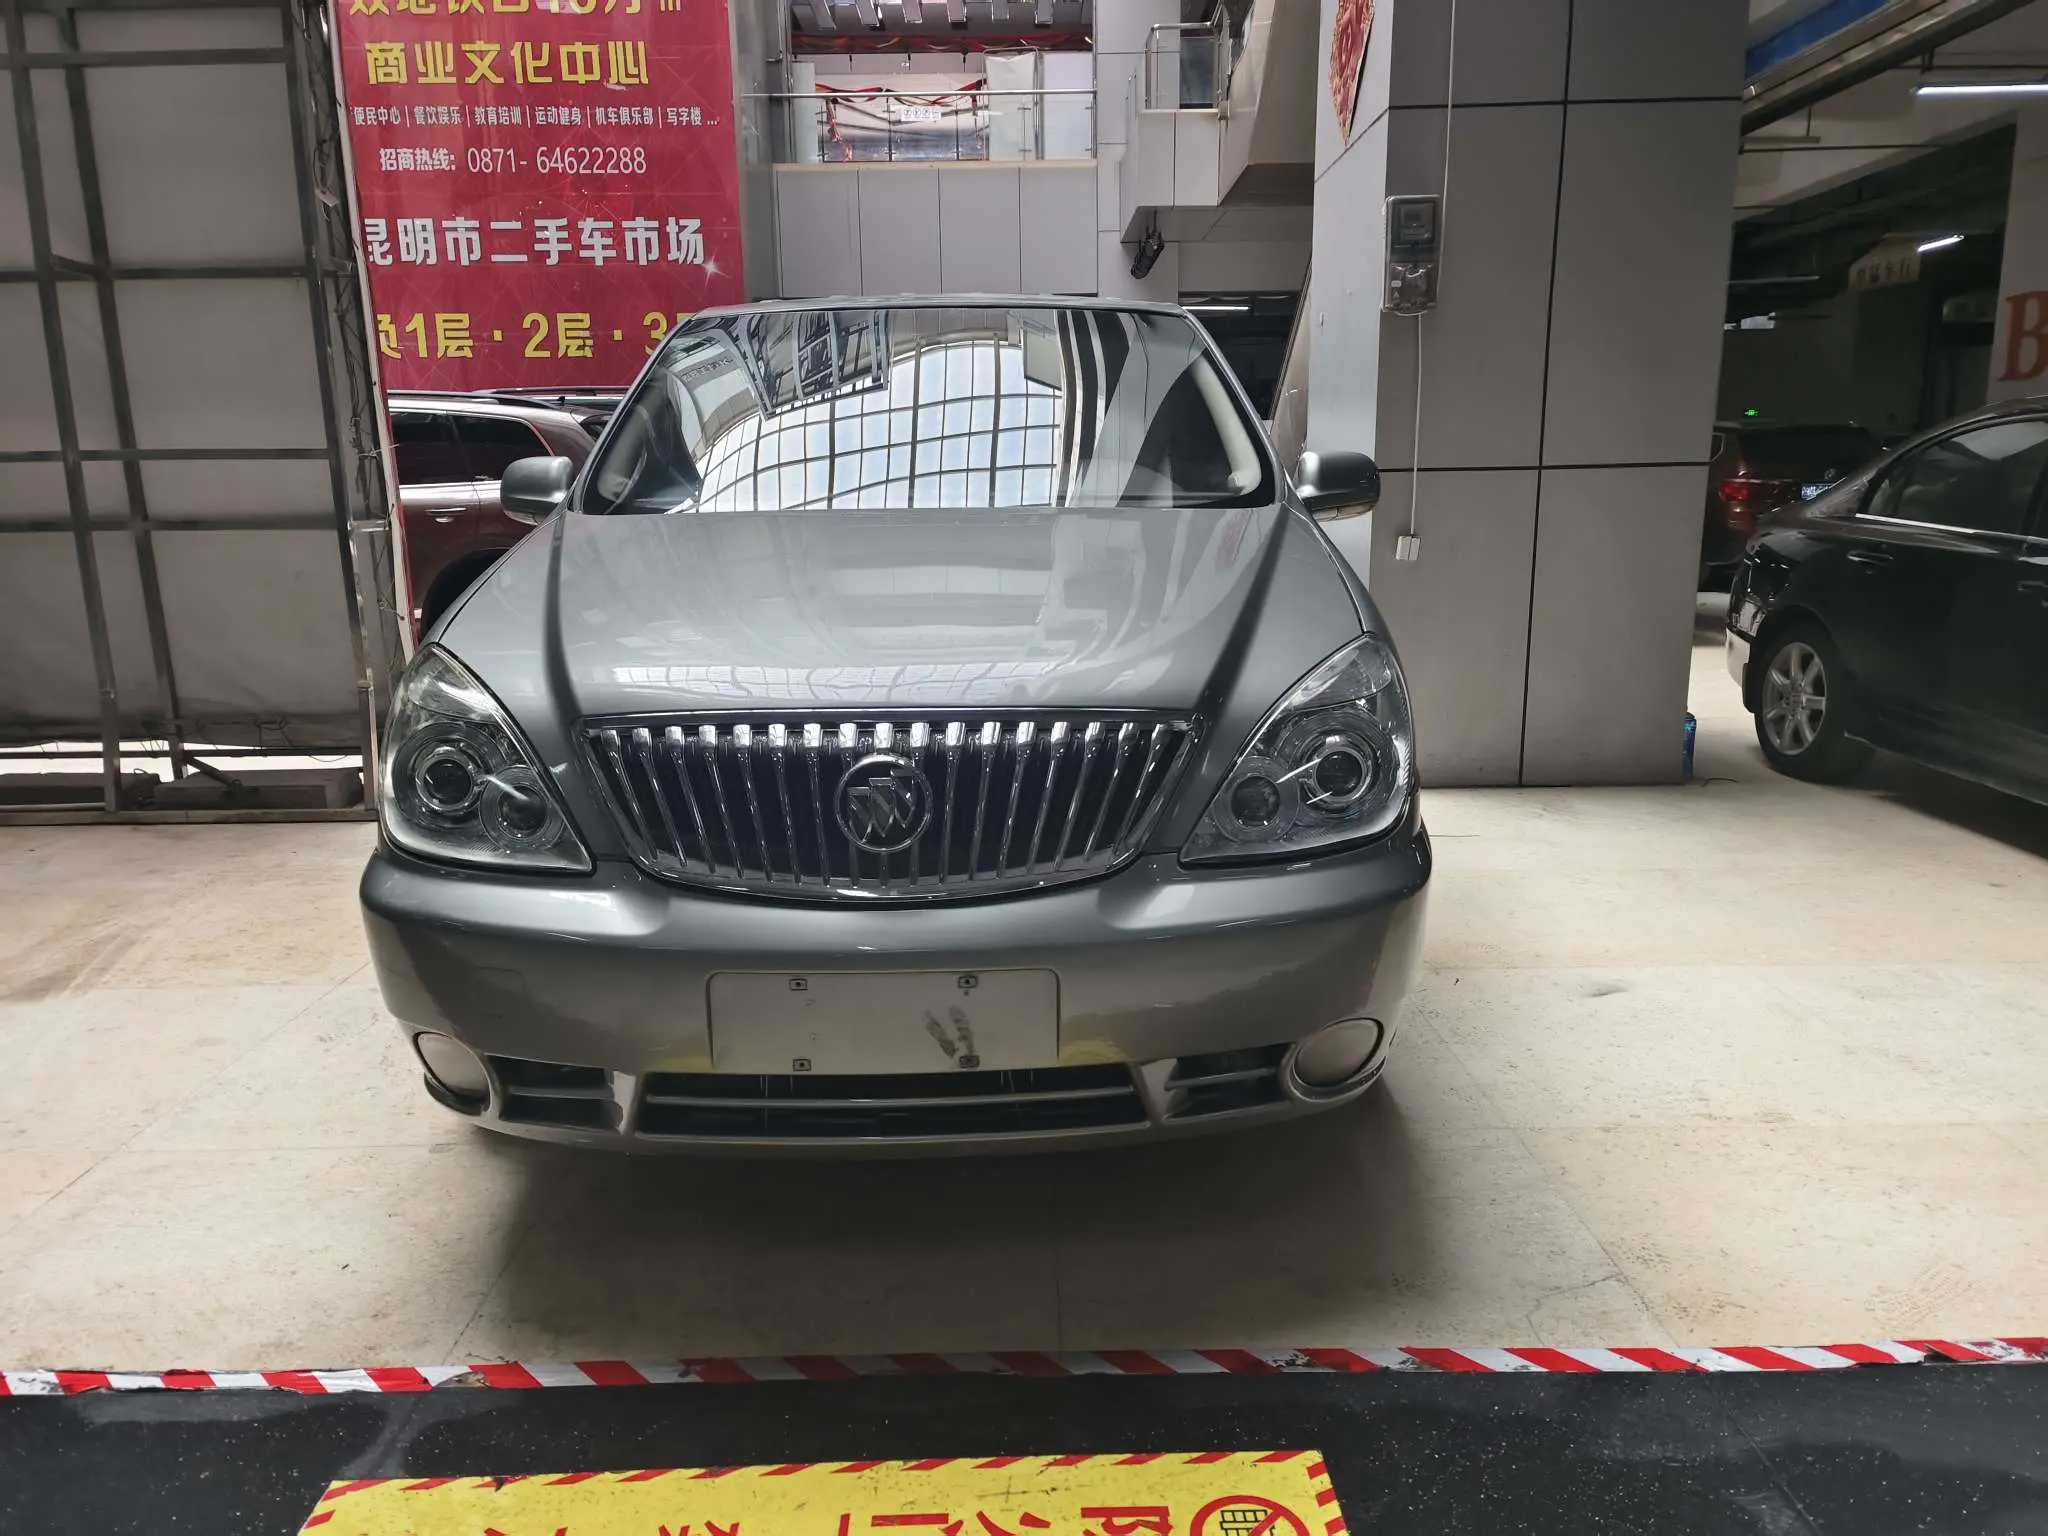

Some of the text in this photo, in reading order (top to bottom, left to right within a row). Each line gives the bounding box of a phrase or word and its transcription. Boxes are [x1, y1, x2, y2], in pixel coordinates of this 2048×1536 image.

[365, 40, 649, 85] 商业文化中心
[353, 107, 401, 125] 便民中心
[413, 107, 461, 125] 餐饮娱乐
[474, 107, 522, 125] 教育培训
[535, 107, 582, 125] 运动健身
[595, 107, 654, 125] 机车俱乐部
[535, 147, 647, 174] 64622288
